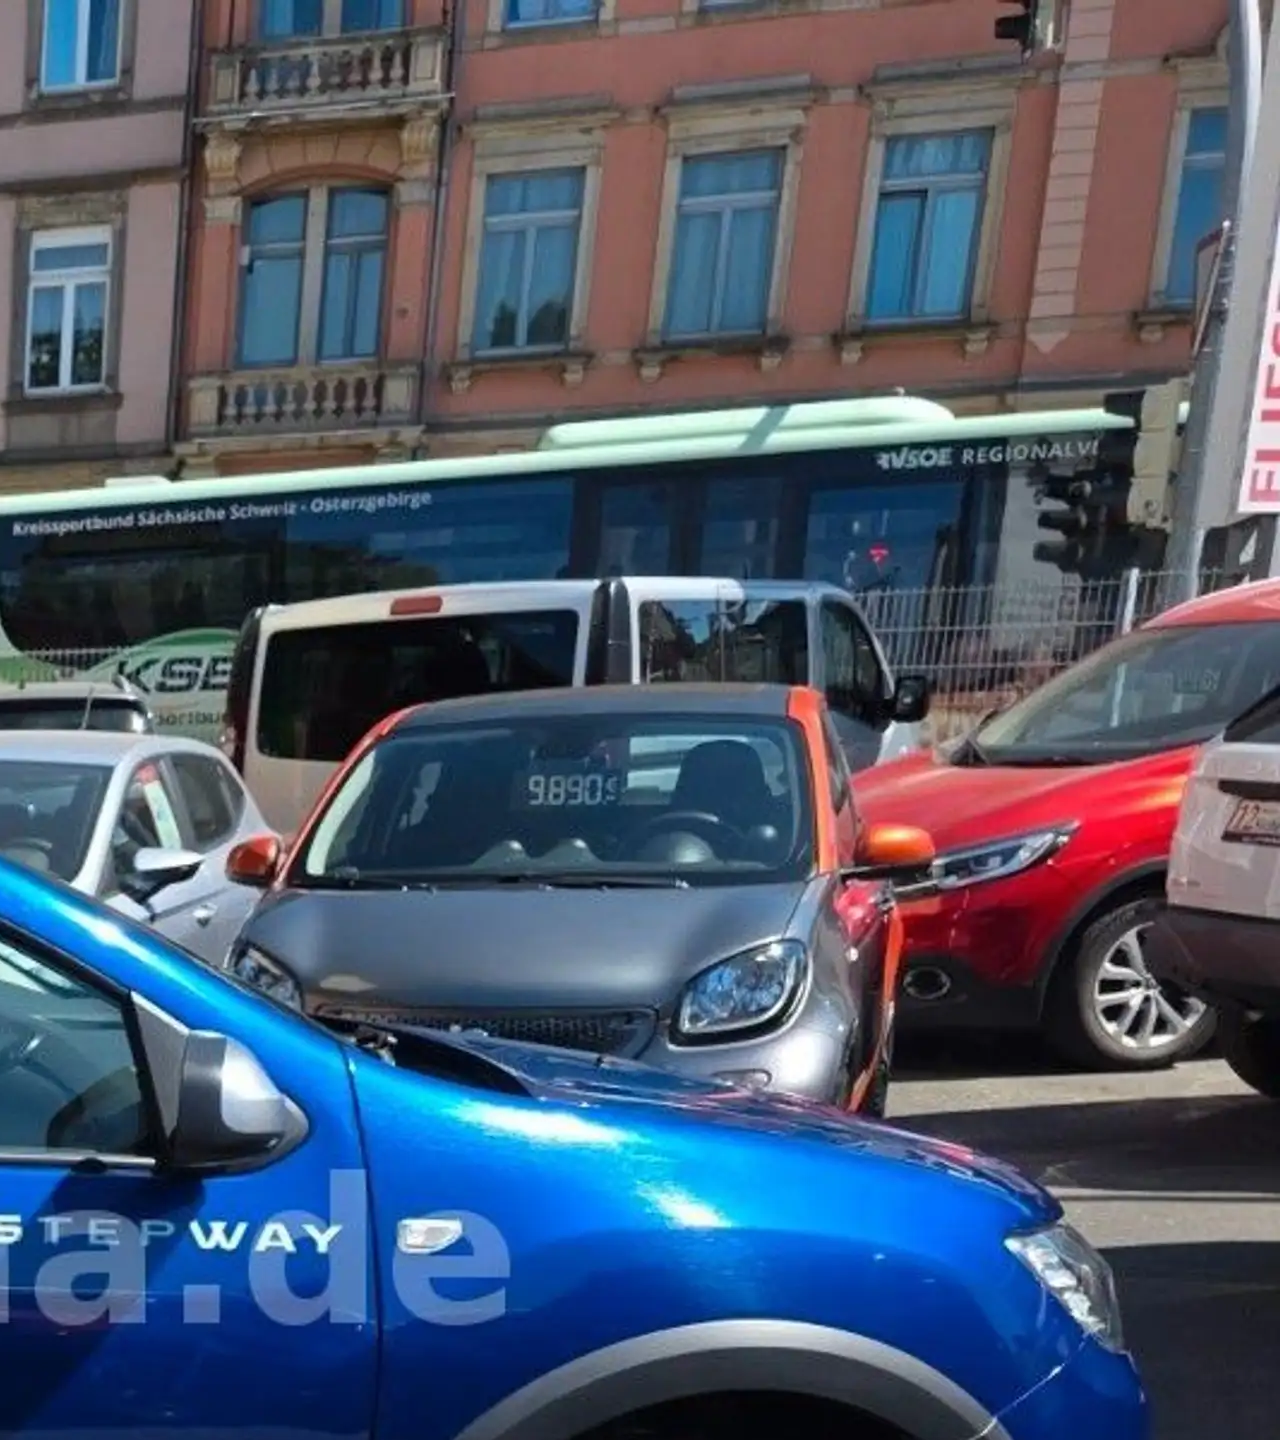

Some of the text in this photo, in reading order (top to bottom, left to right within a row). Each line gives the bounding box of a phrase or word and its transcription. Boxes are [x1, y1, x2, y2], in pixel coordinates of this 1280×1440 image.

[12, 512, 134, 537] Kreissportbund
[137, 506, 226, 527] Sächsische
[229, 500, 297, 520] Schweiz
[310, 491, 432, 513] Osterzgebirge
